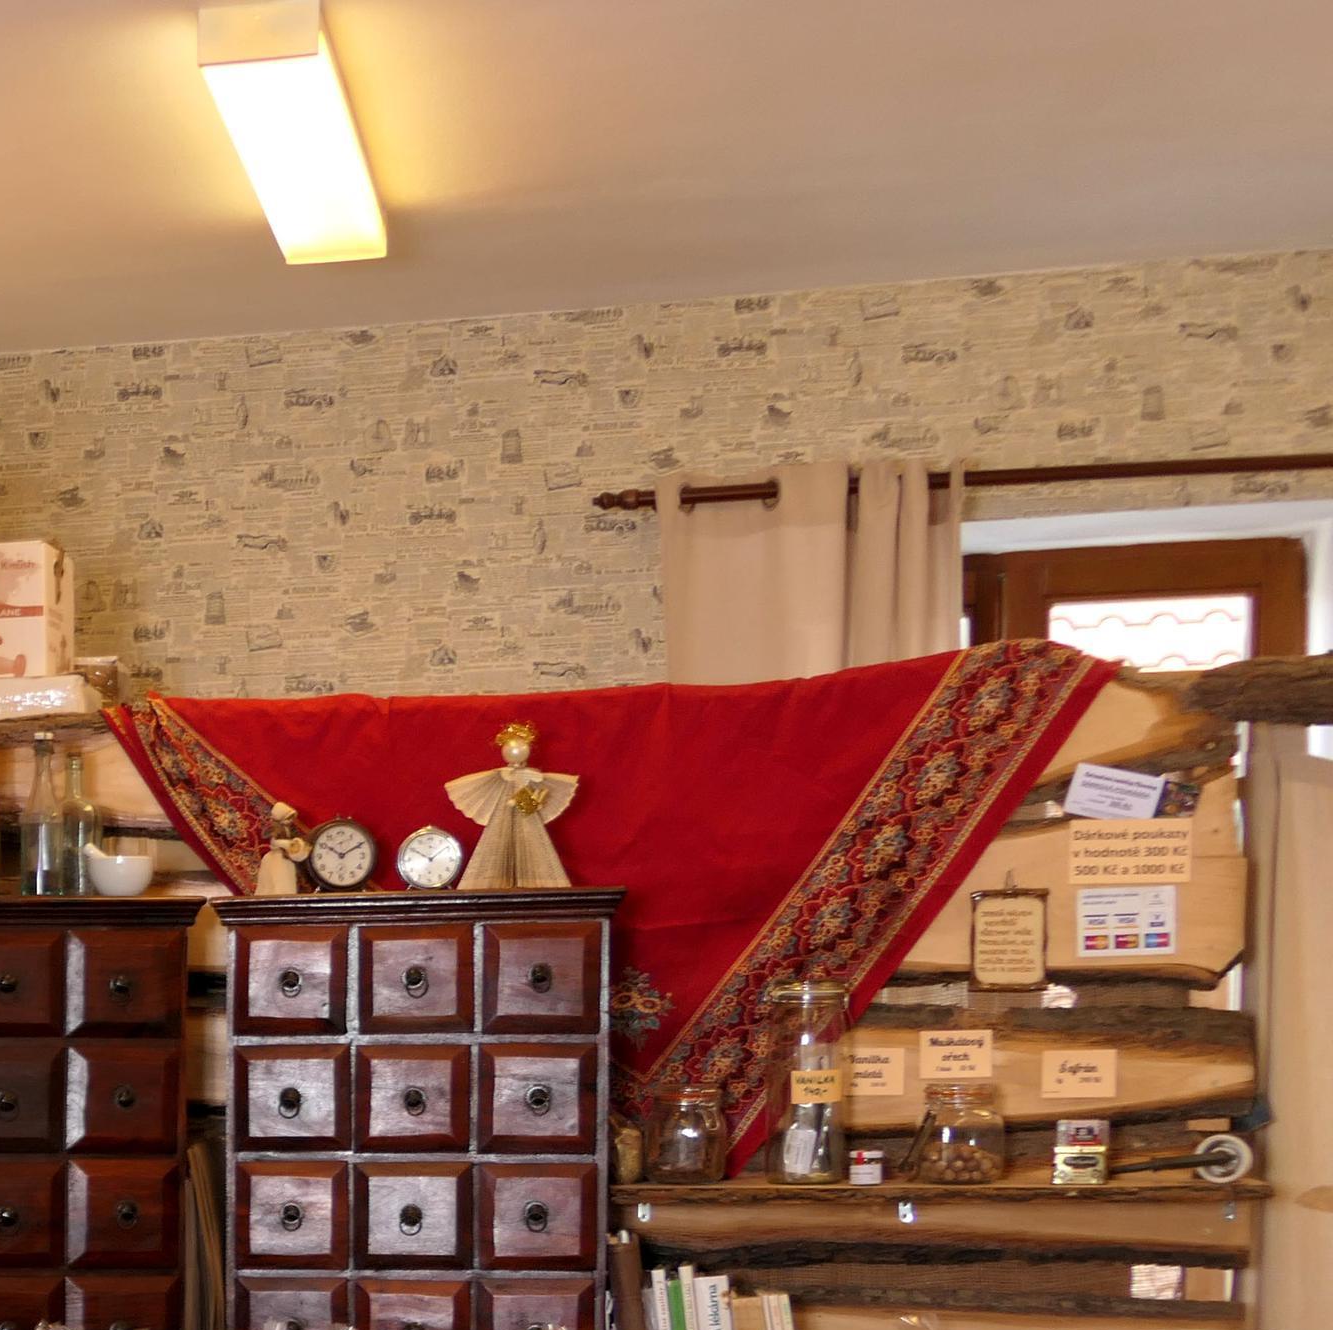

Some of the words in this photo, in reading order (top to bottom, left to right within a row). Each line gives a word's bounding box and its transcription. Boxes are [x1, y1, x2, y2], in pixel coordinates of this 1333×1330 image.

[1073, 828, 1130, 843] Dárkové
[1133, 829, 1190, 844] poukazy
[1084, 845, 1141, 859] hodnotě
[1144, 846, 1169, 858] 300
[1172, 844, 1188, 858] Kč
[1074, 865, 1100, 878] 500
[1102, 863, 1118, 877] Kč
[1134, 864, 1167, 876] 1000
[1169, 862, 1186, 876] Kč
[794, 1075, 837, 1087] VANILKA
[707, 1283, 723, 1323] lékárna
